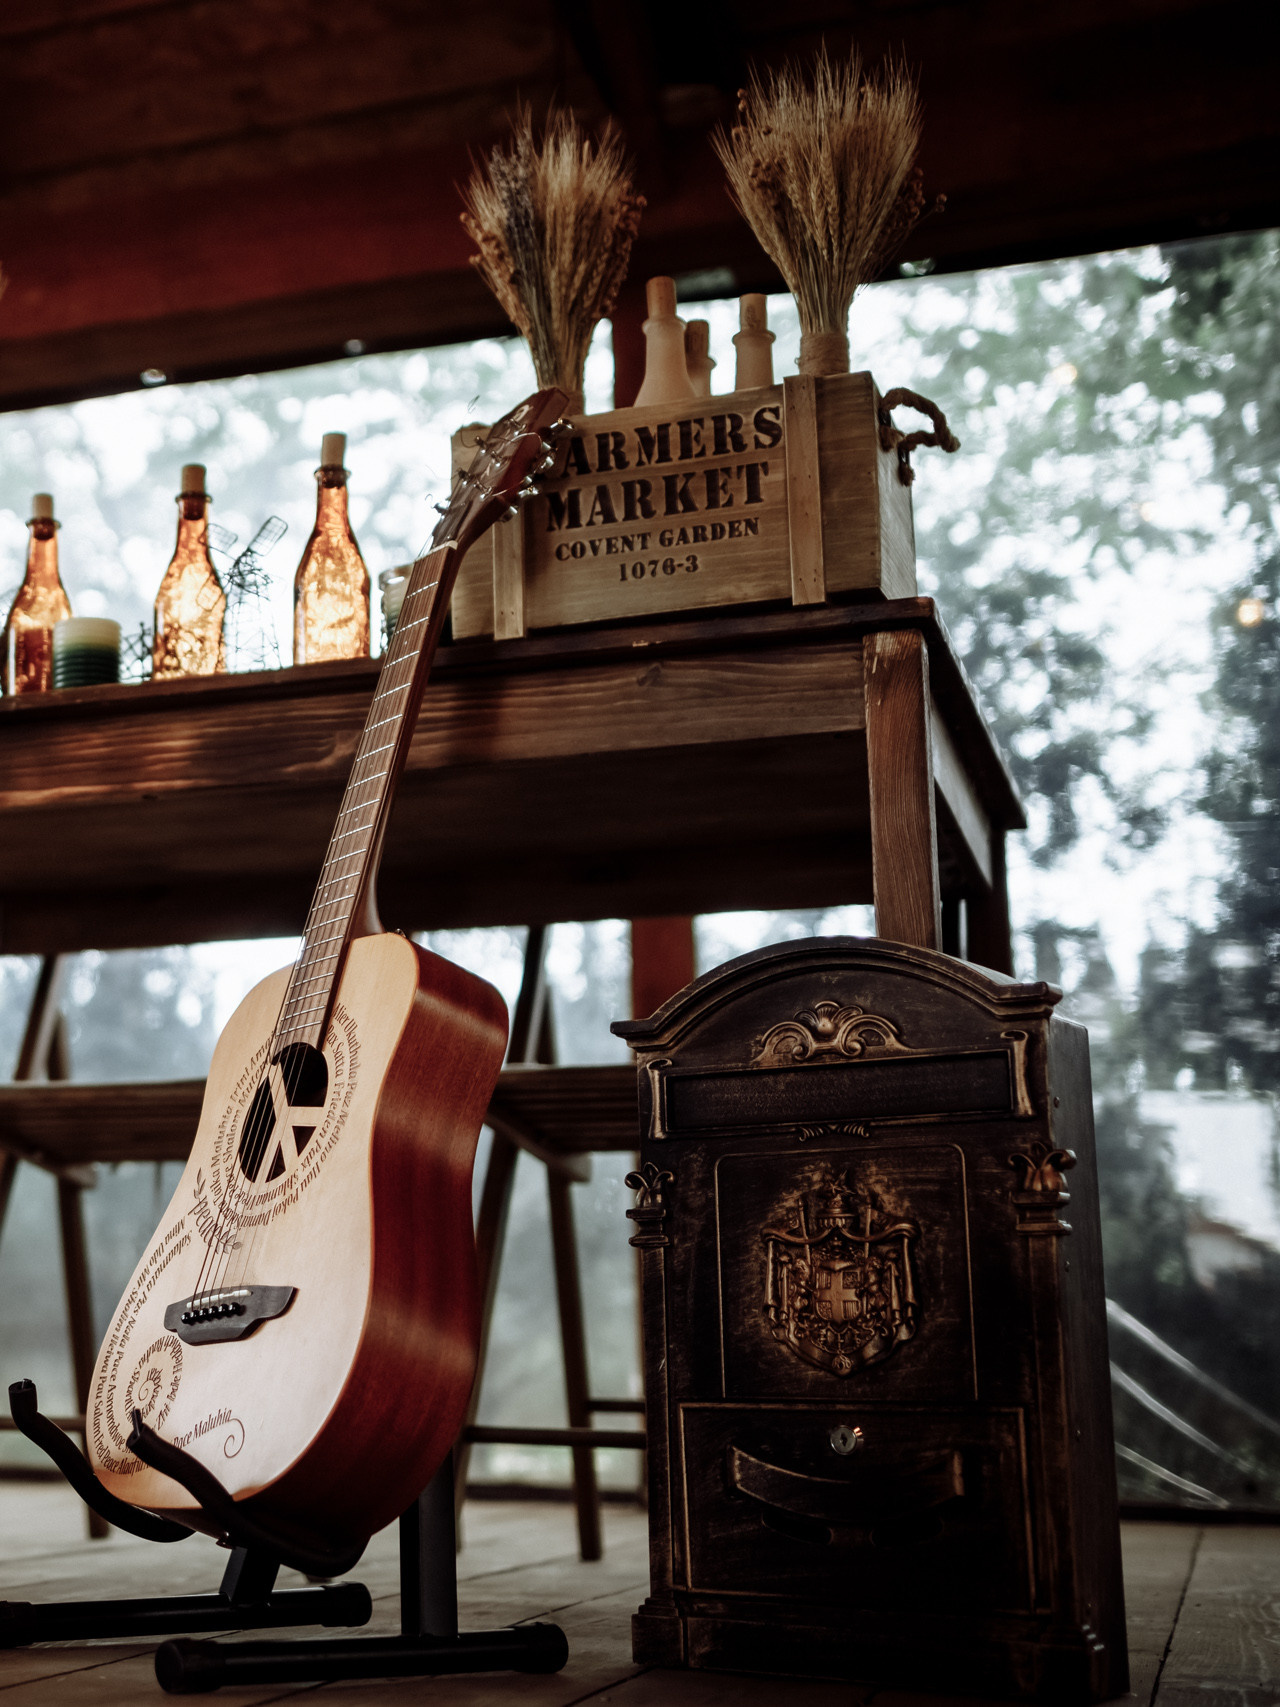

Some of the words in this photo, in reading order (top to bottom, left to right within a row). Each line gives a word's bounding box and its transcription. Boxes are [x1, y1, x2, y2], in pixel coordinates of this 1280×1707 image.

[561, 405, 783, 478] ARMERS
[546, 461, 770, 532] MARKET
[554, 532, 652, 561] COVENT
[659, 517, 759, 548] GARDEN
[619, 554, 700, 581] 1076-3
